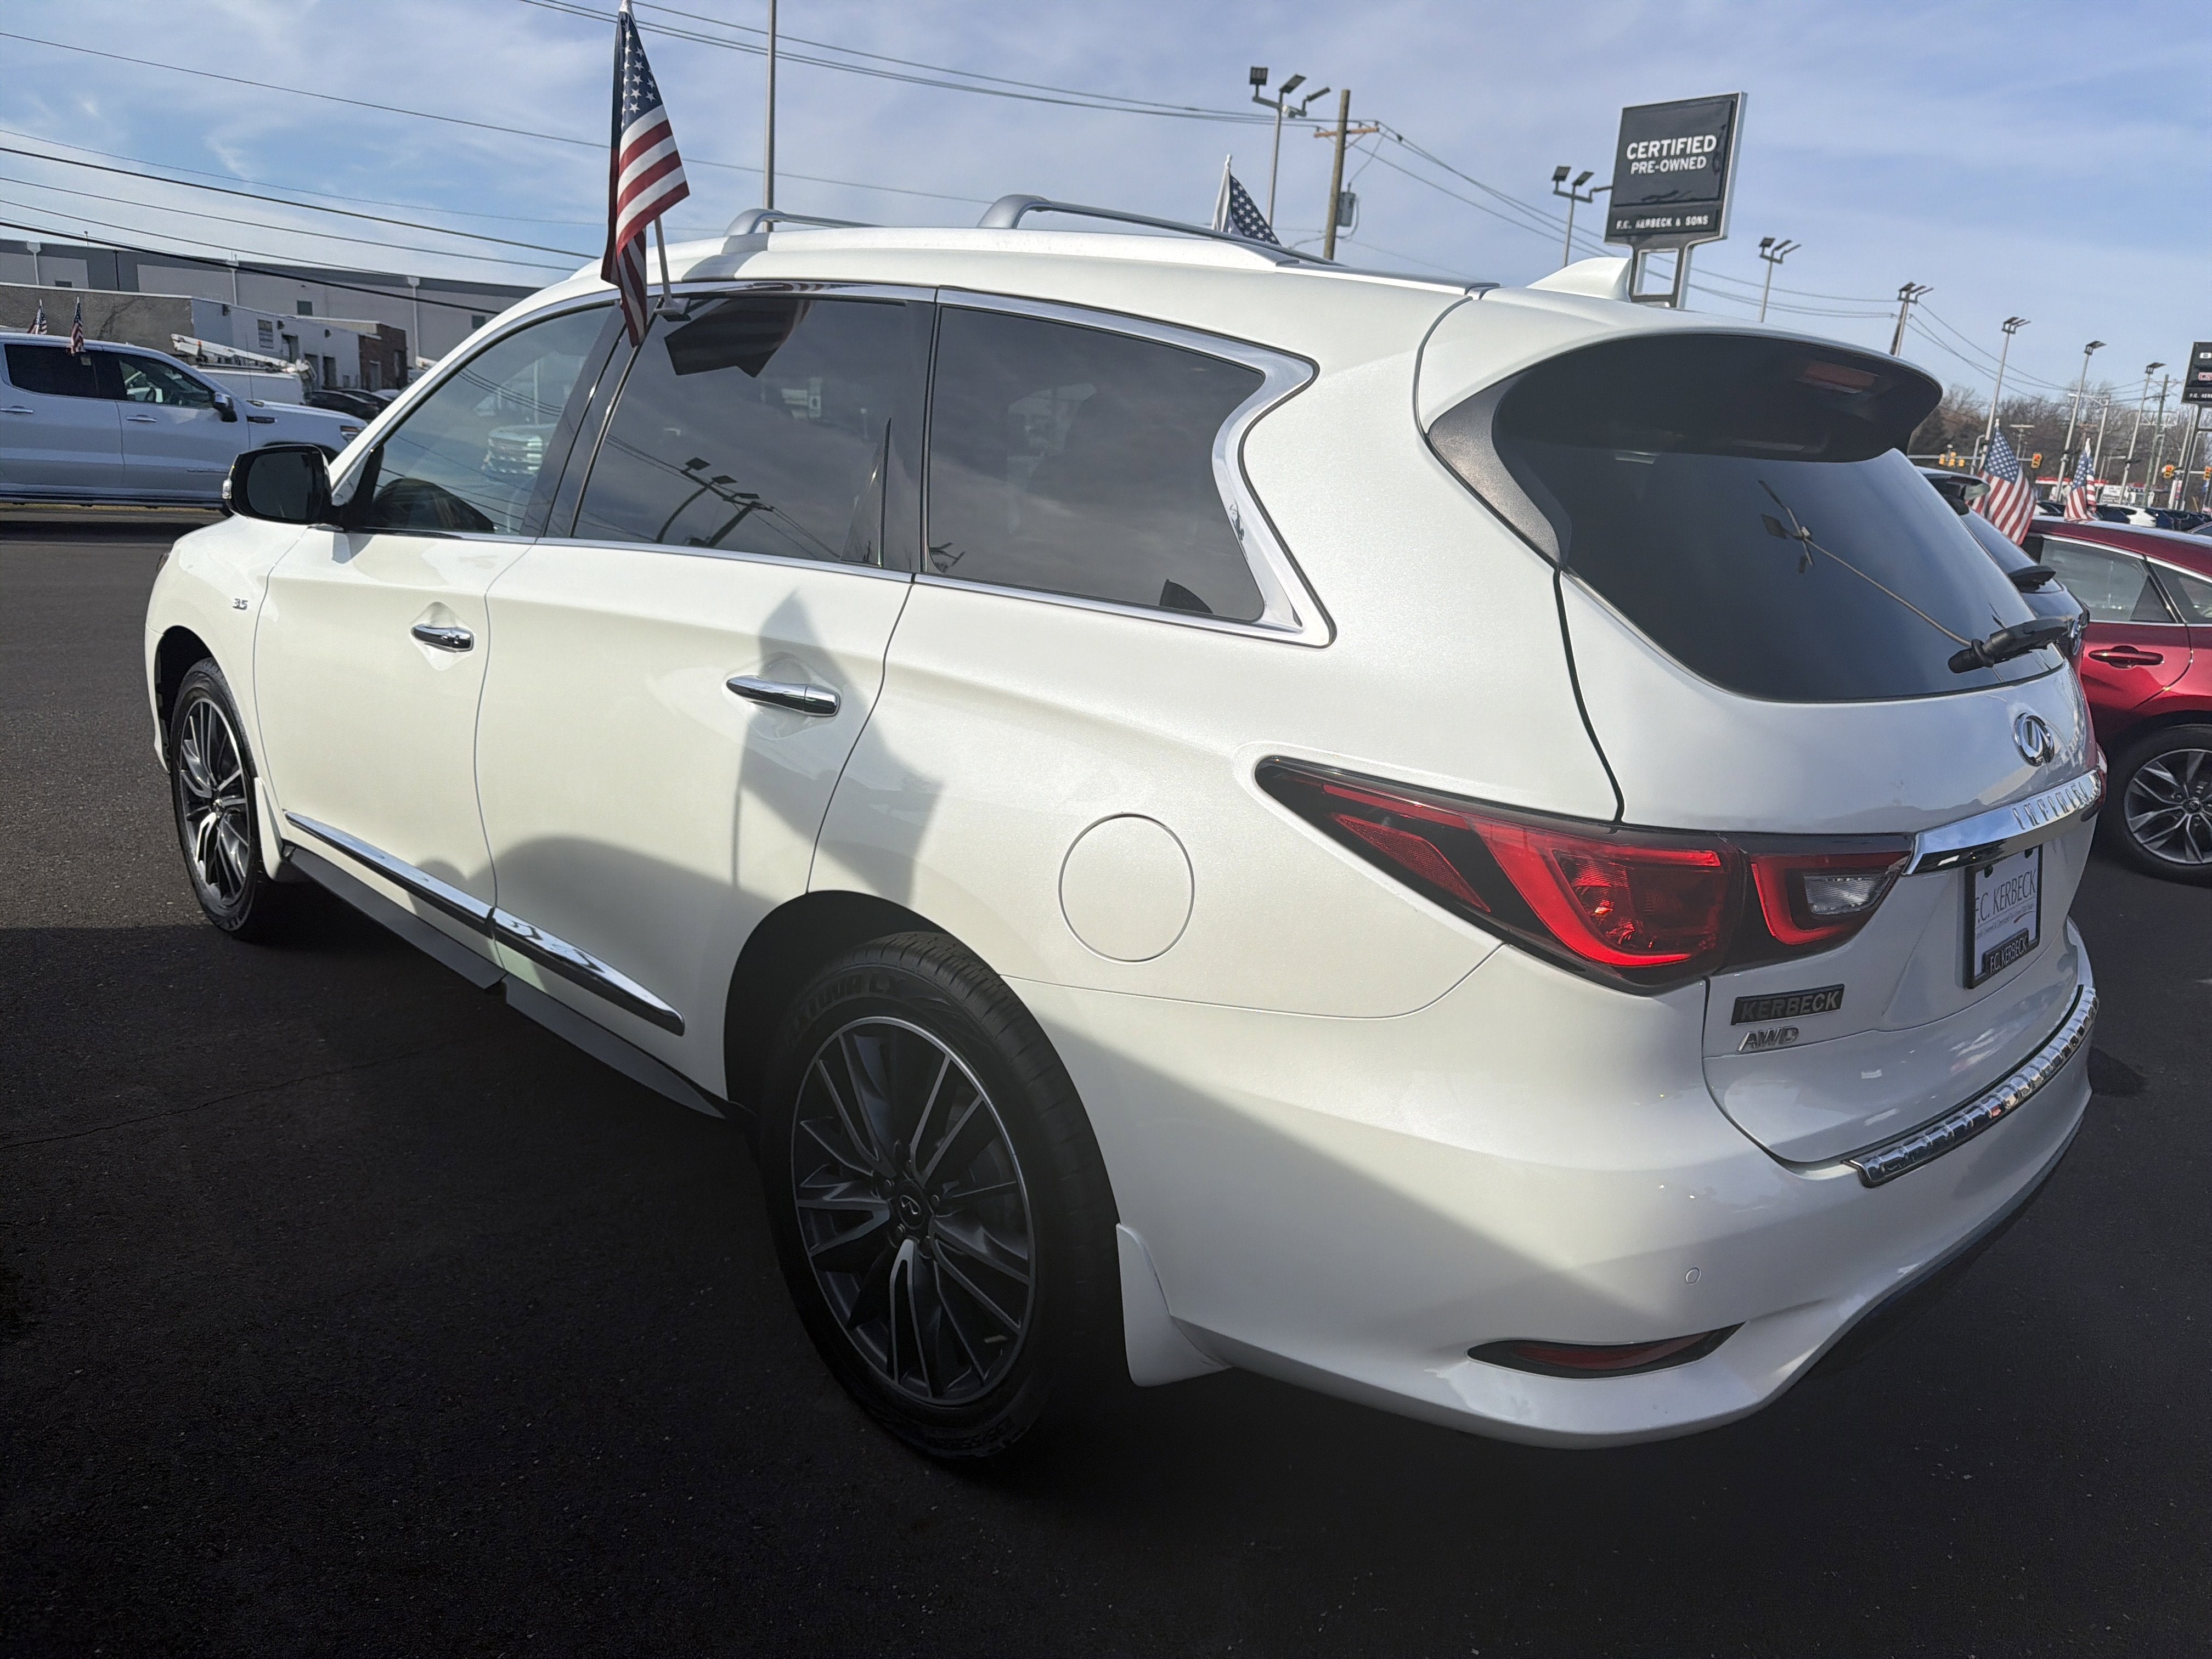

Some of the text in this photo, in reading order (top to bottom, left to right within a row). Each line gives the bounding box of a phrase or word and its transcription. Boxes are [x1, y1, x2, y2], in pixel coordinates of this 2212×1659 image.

[1627, 135, 1717, 160] CERTIFIED
[1630, 156, 1707, 175] PRE-OWNED
[1685, 215, 1708, 226] SONS
[2012, 781, 2090, 830] INFINITI
[1993, 868, 2036, 915] KERBECK
[1990, 935, 2027, 973] F.C. KERBECK
[1741, 990, 1842, 1020] KERBECK
[1736, 1025, 1799, 1052] AWD
